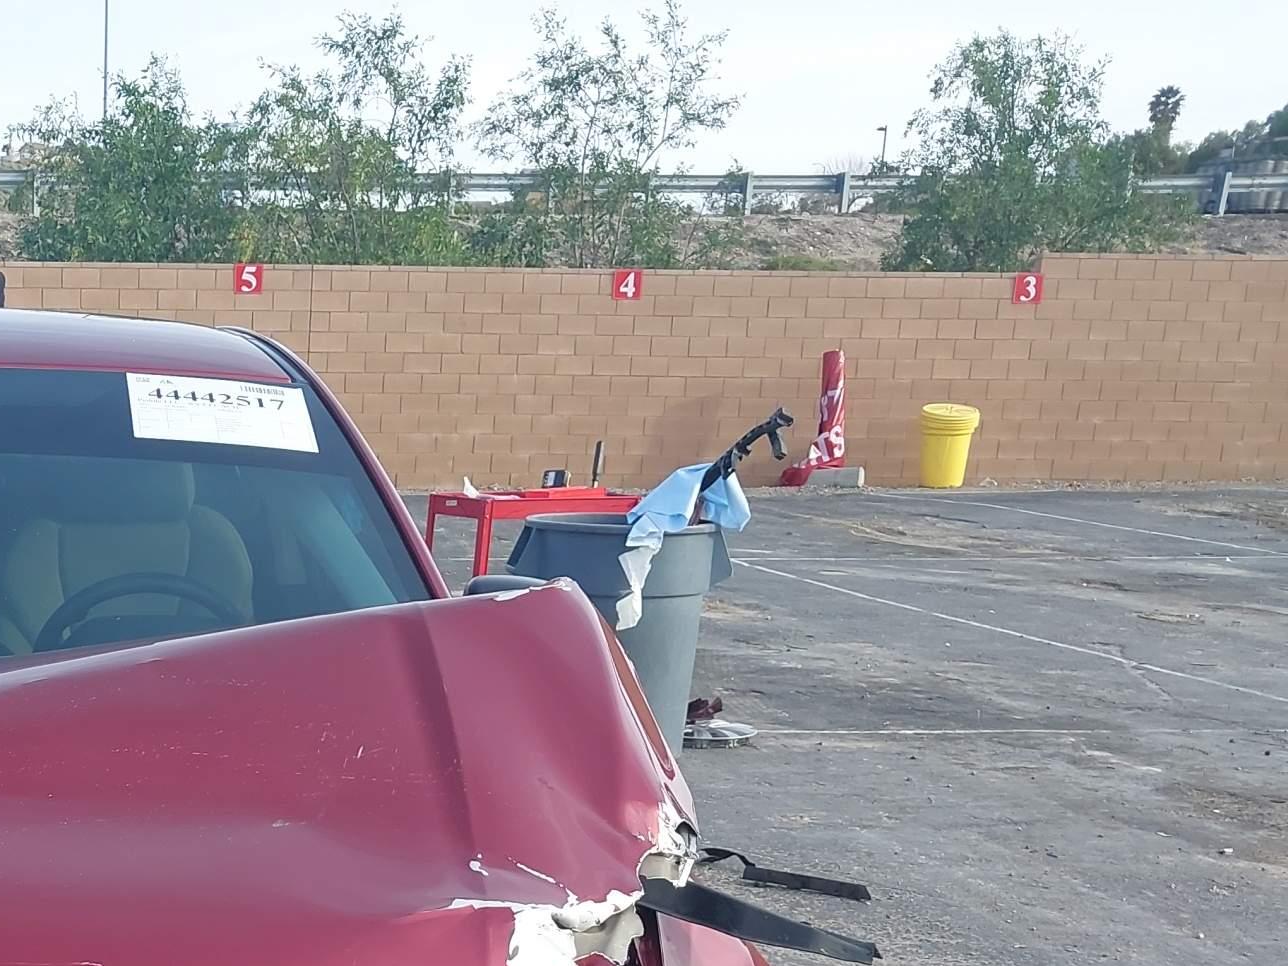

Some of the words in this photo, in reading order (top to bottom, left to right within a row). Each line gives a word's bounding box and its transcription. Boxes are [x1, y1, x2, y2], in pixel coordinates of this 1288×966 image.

[240, 266, 258, 292] 5
[619, 271, 637, 298] 4
[1019, 275, 1037, 302] 3
[147, 387, 285, 410] 44442517
